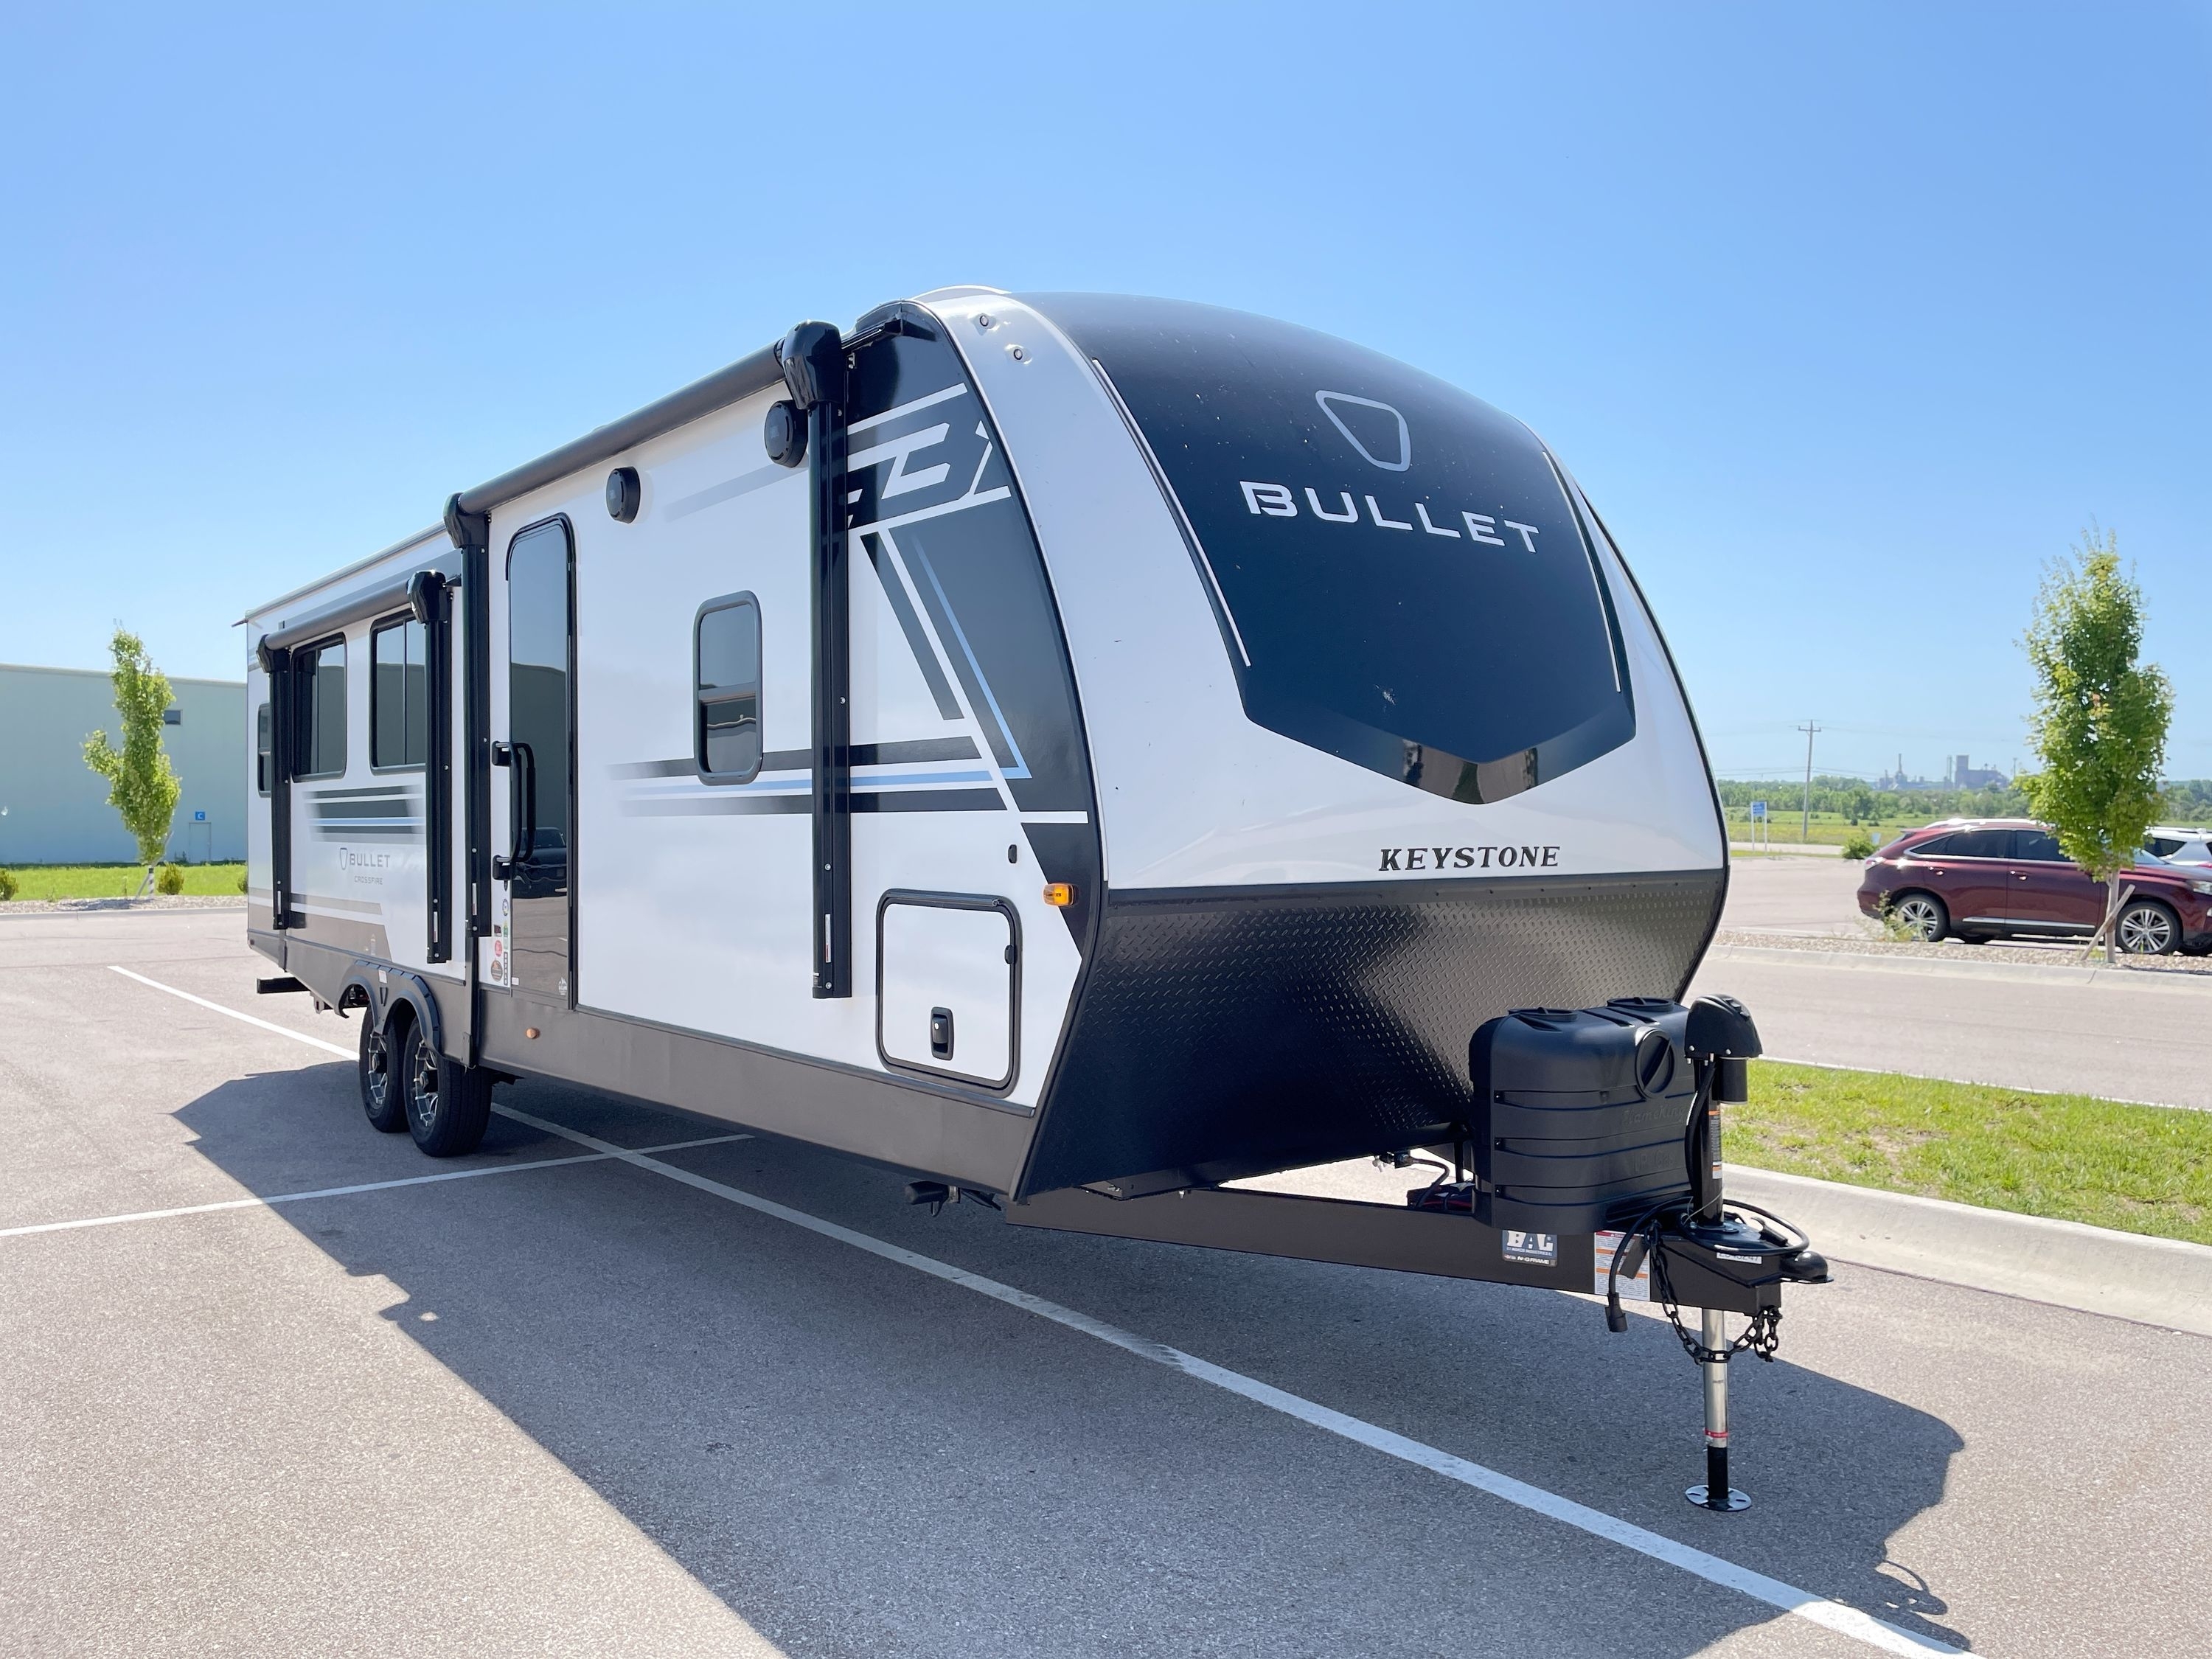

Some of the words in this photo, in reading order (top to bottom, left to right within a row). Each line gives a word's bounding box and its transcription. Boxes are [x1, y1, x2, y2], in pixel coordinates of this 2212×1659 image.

[1239, 481, 1540, 553] BULLET
[349, 853, 391, 868] BULLET
[1378, 846, 1560, 871] KEYSTONE
[354, 875, 383, 885] CROSSFIRE
[1506, 1230, 1554, 1252] BAL
